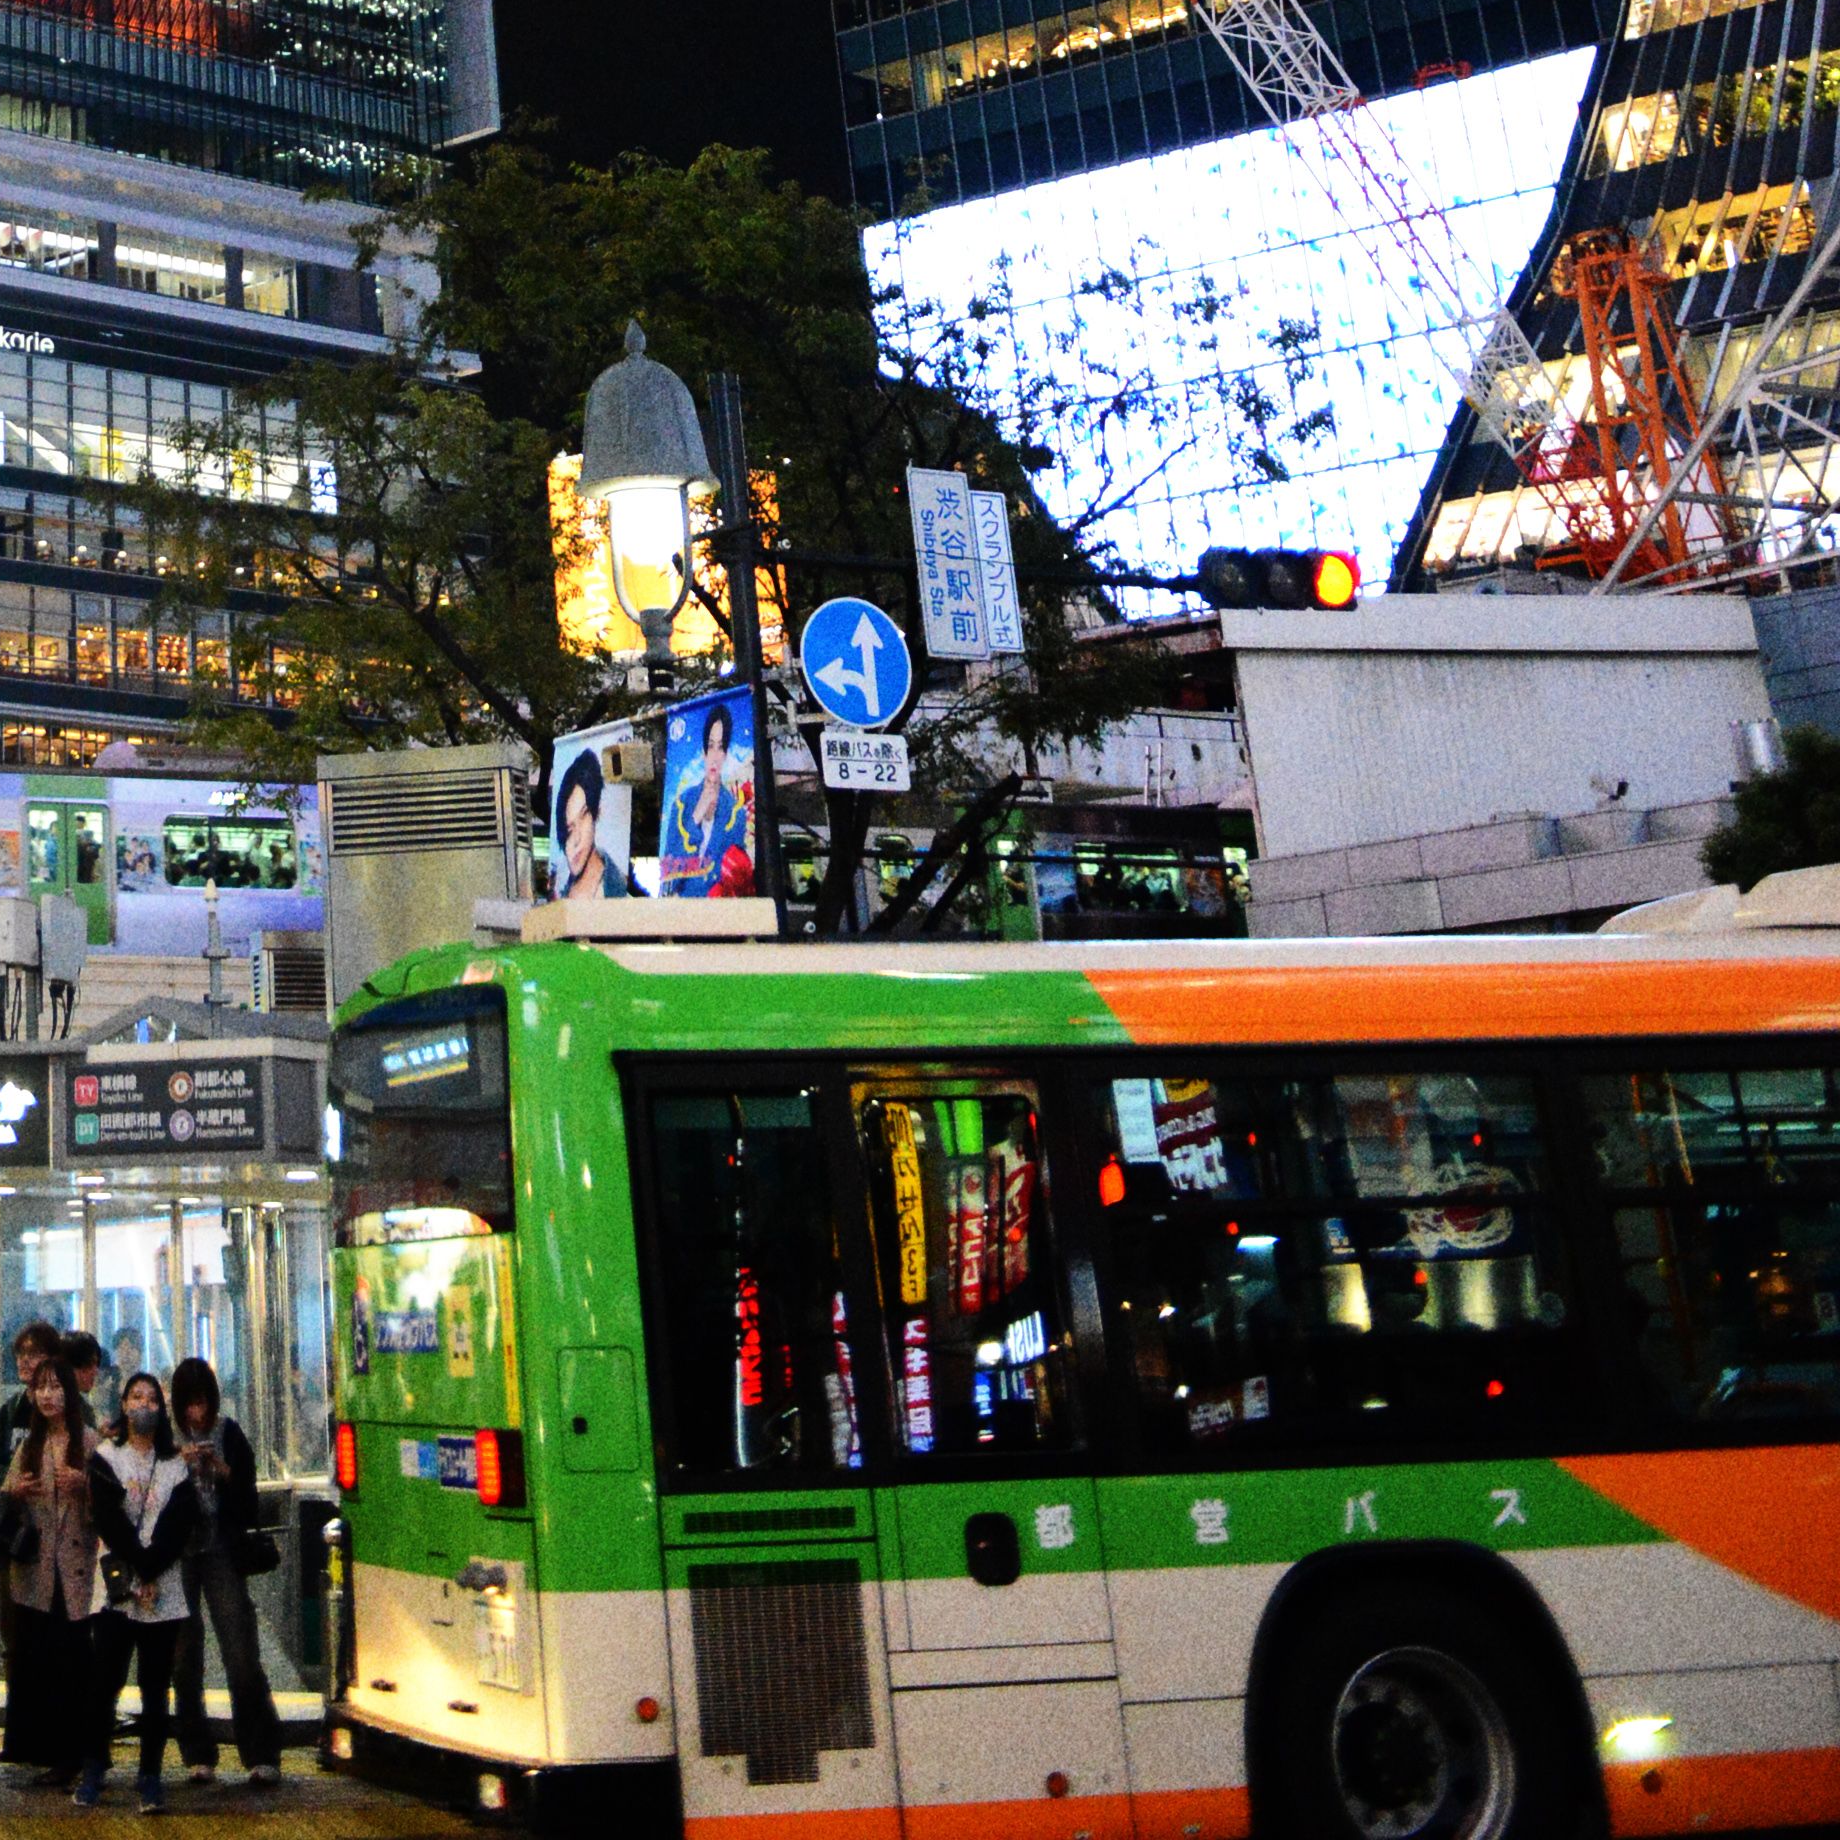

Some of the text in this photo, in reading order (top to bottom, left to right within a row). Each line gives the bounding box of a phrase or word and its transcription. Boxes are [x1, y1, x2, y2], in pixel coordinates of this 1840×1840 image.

[920, 509, 944, 617] Shibuya Sta
[936, 488, 978, 643] 渋谷駅前
[979, 498, 1014, 645] スクランブル式
